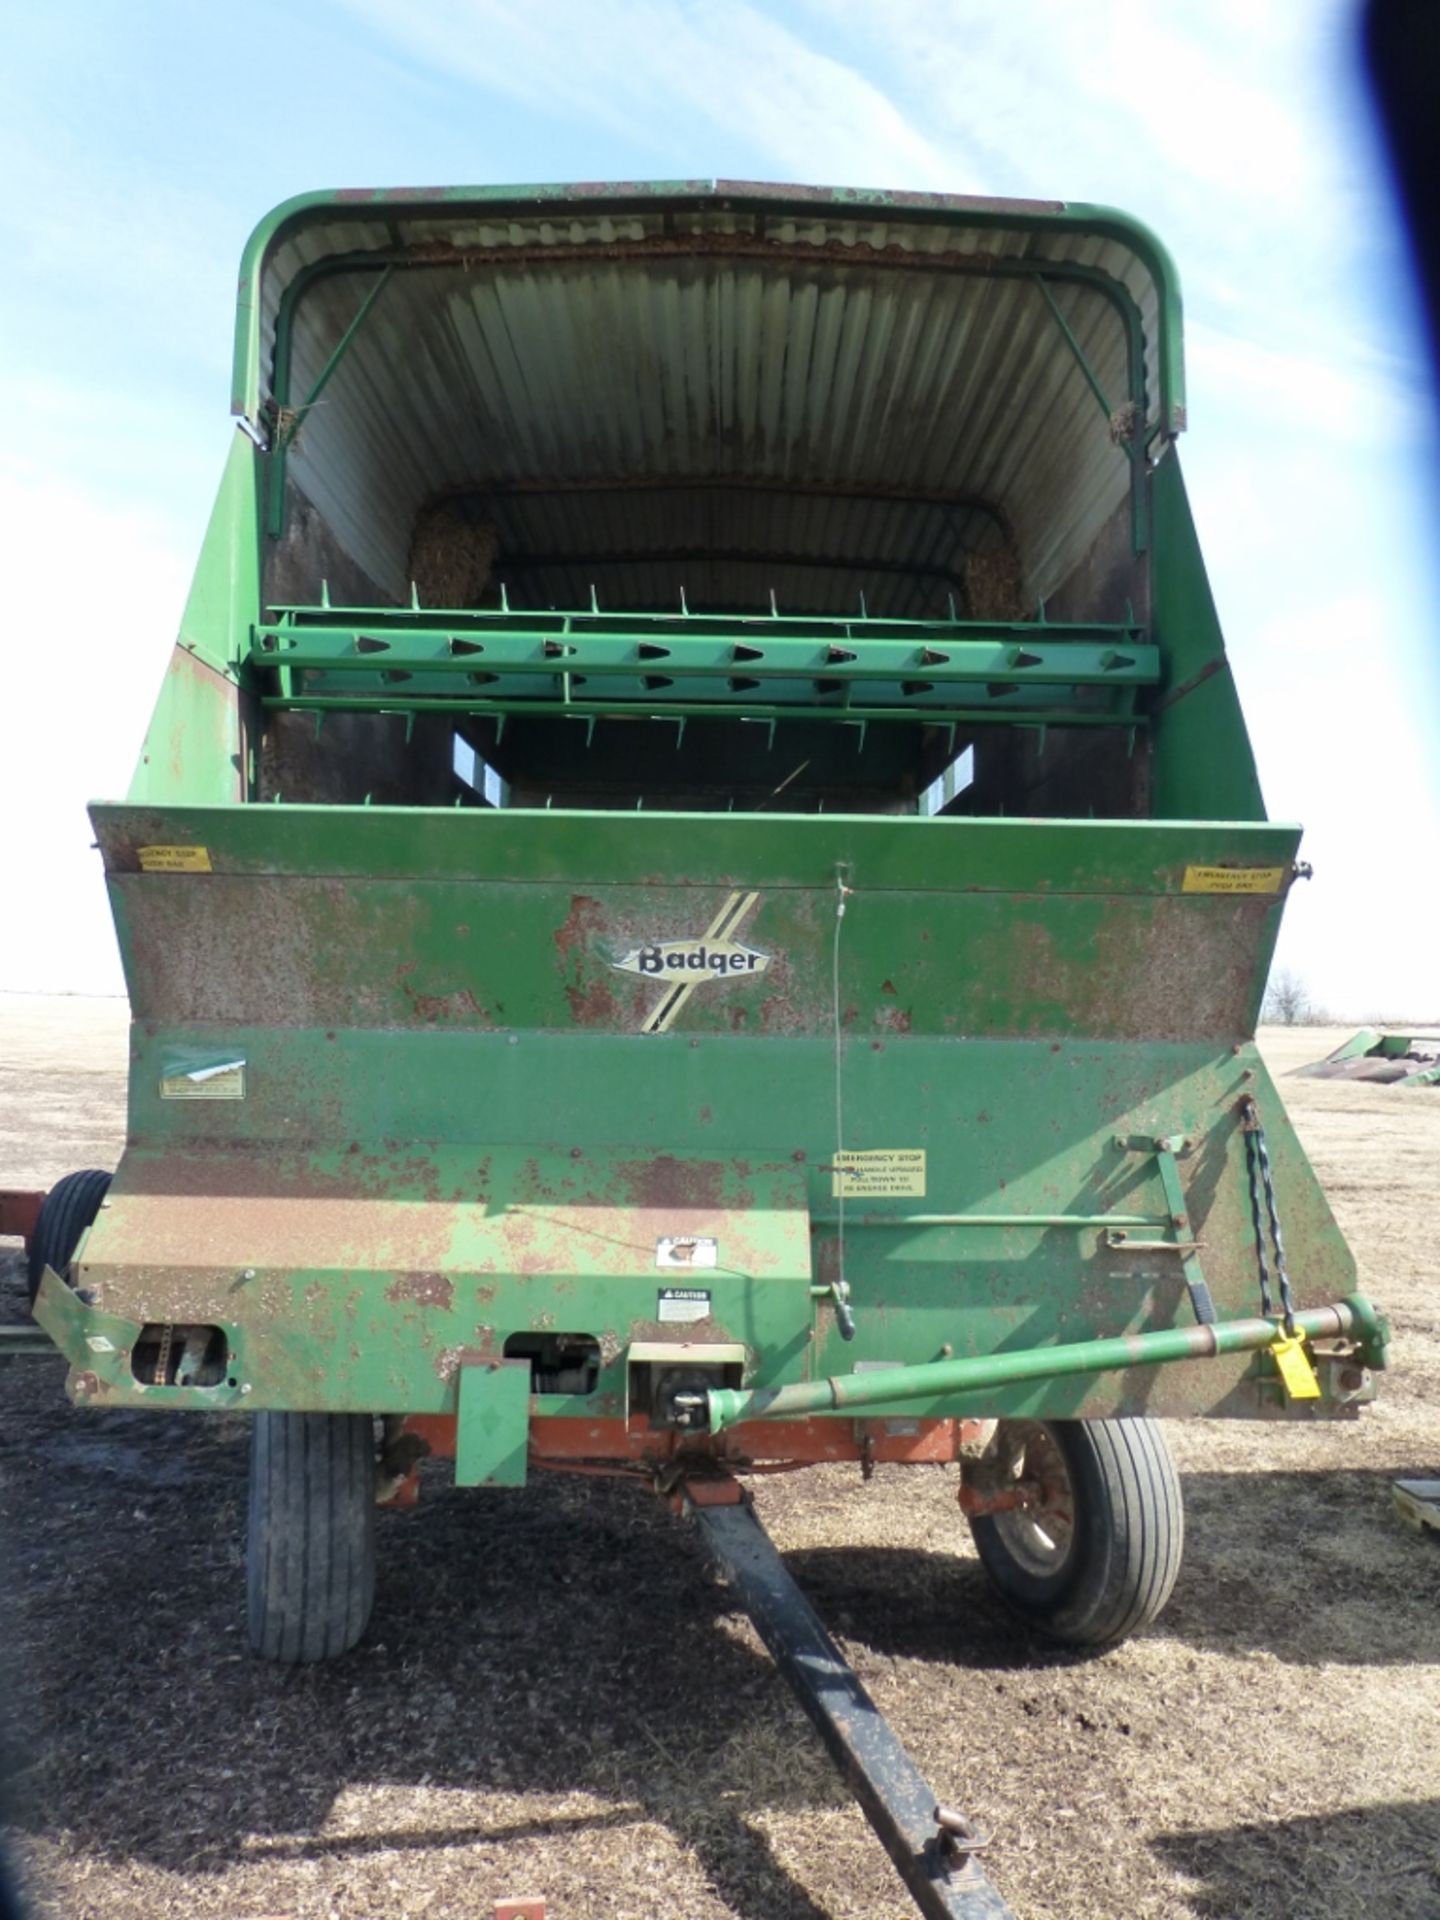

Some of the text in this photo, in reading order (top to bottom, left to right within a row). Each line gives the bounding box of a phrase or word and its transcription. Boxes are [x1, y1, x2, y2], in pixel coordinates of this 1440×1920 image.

[835, 1154, 922, 1162] EMERGENCY STOP
[674, 1290, 708, 1300] CAUTION
